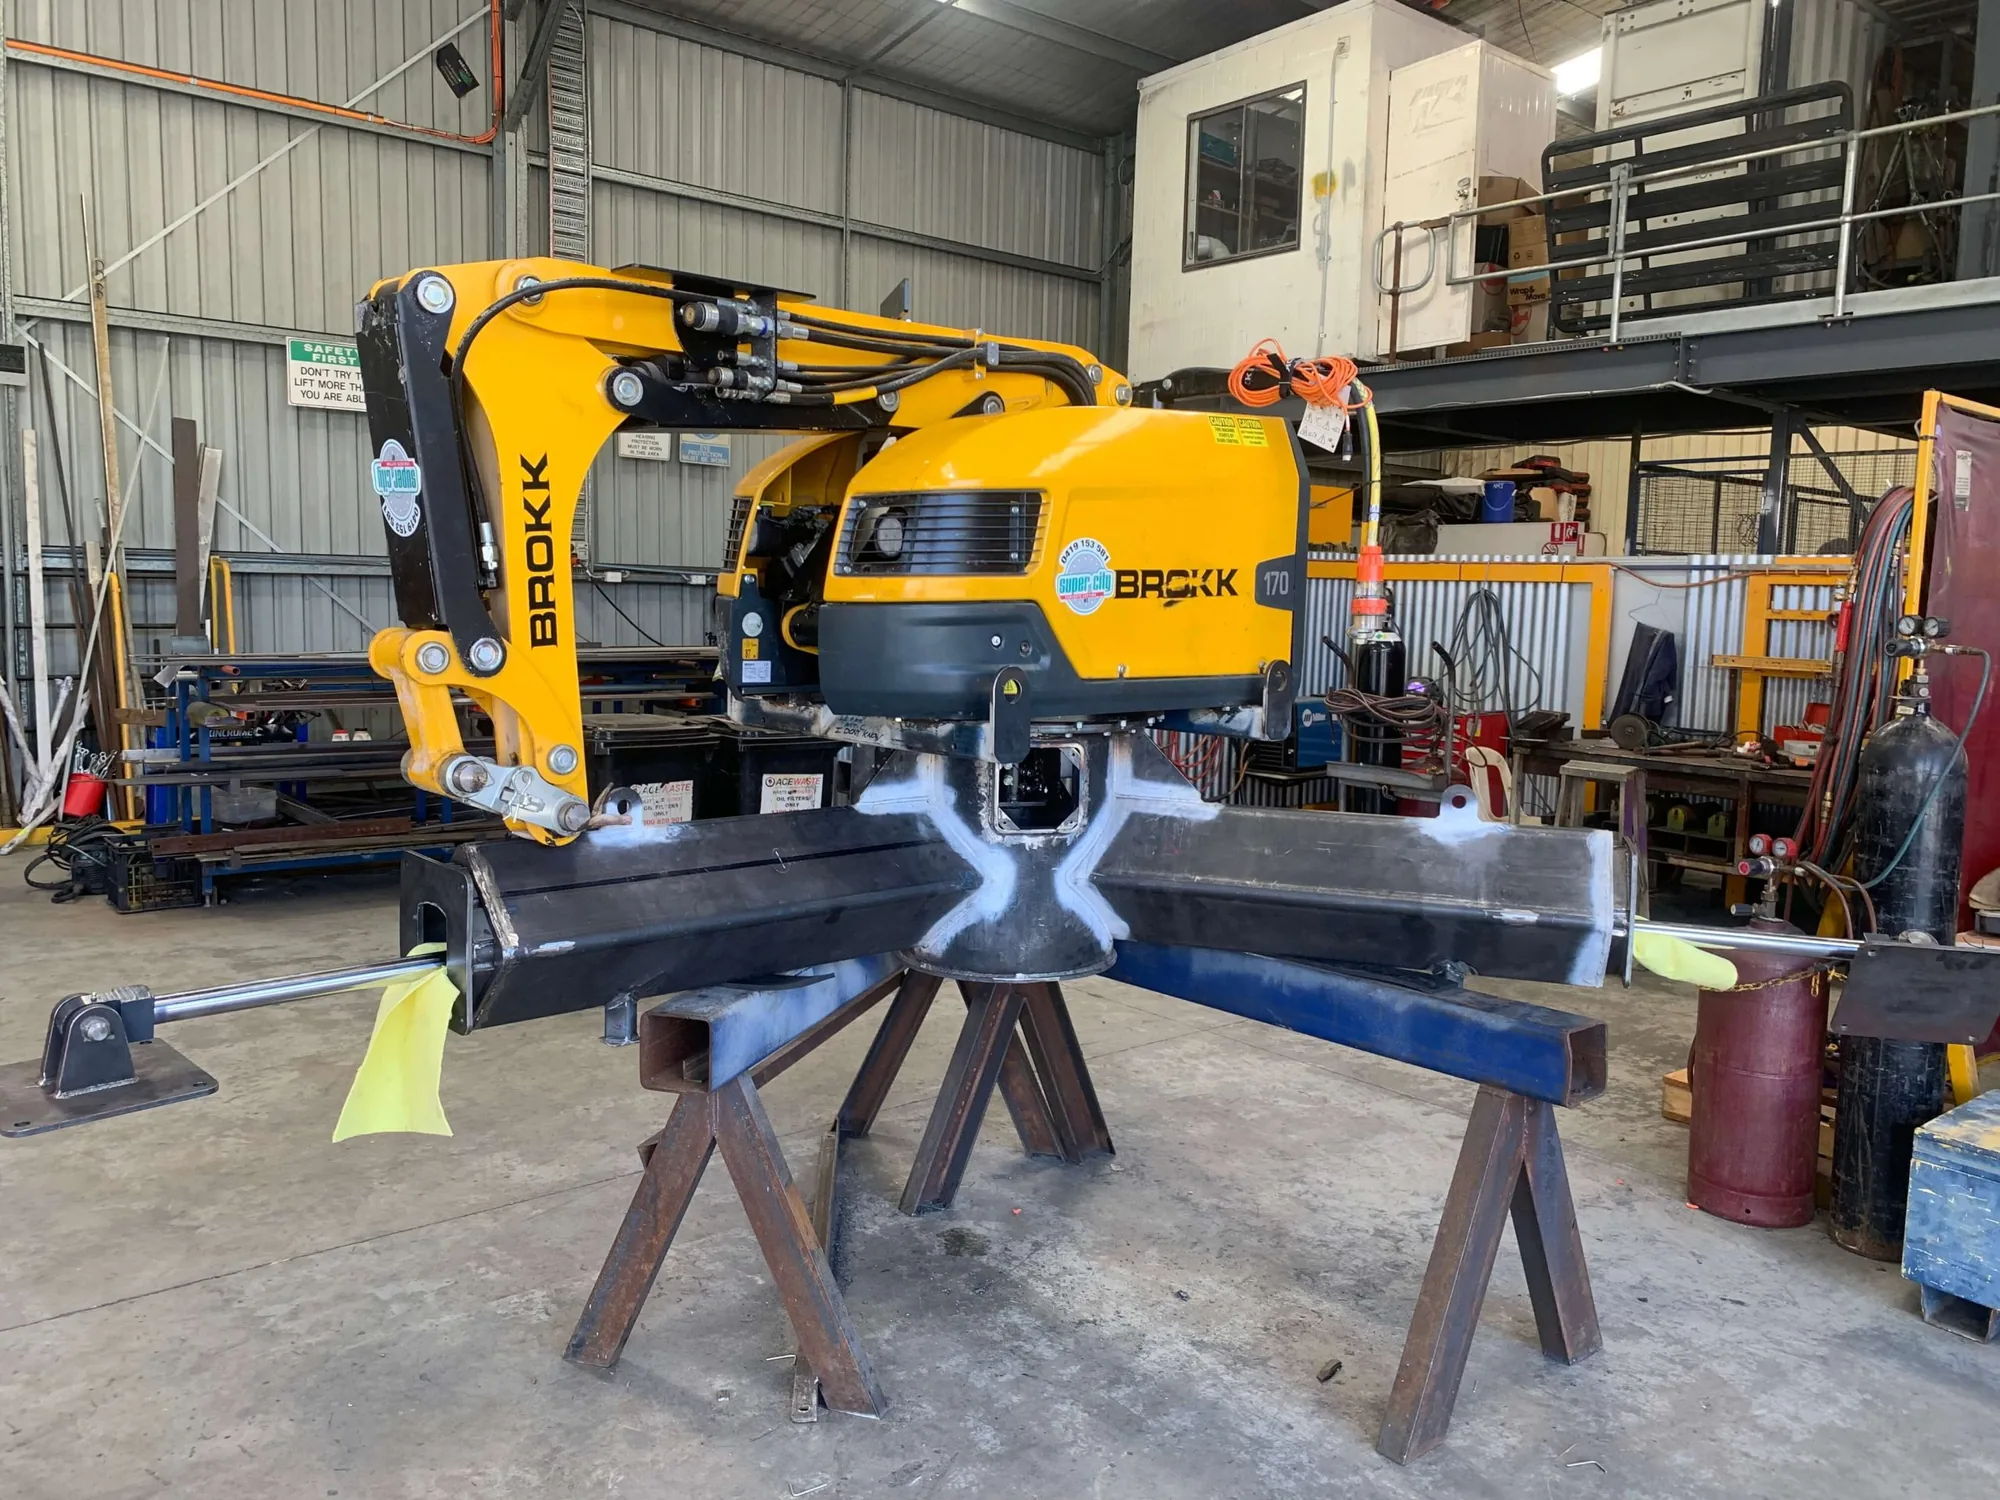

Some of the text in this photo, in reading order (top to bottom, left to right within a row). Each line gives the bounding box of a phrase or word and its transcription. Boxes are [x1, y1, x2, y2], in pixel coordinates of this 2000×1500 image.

[1526, 292, 1546, 300] Move
[312, 353, 357, 366] FIRST
[300, 366, 363, 380] DON'T TRY T
[294, 378, 364, 392] LIFT MORE TH
[300, 389, 364, 404] YOU ARE ABL
[1211, 417, 1235, 426] CAUTION
[1239, 420, 1262, 428] CAUTION
[687, 449, 723, 458] PROTECTION
[520, 452, 558, 650] BROKK
[1061, 539, 1109, 564] 0419 153 581
[1059, 572, 1112, 595] super city
[1113, 568, 1239, 600] BROKK
[1264, 571, 1289, 596] 170
